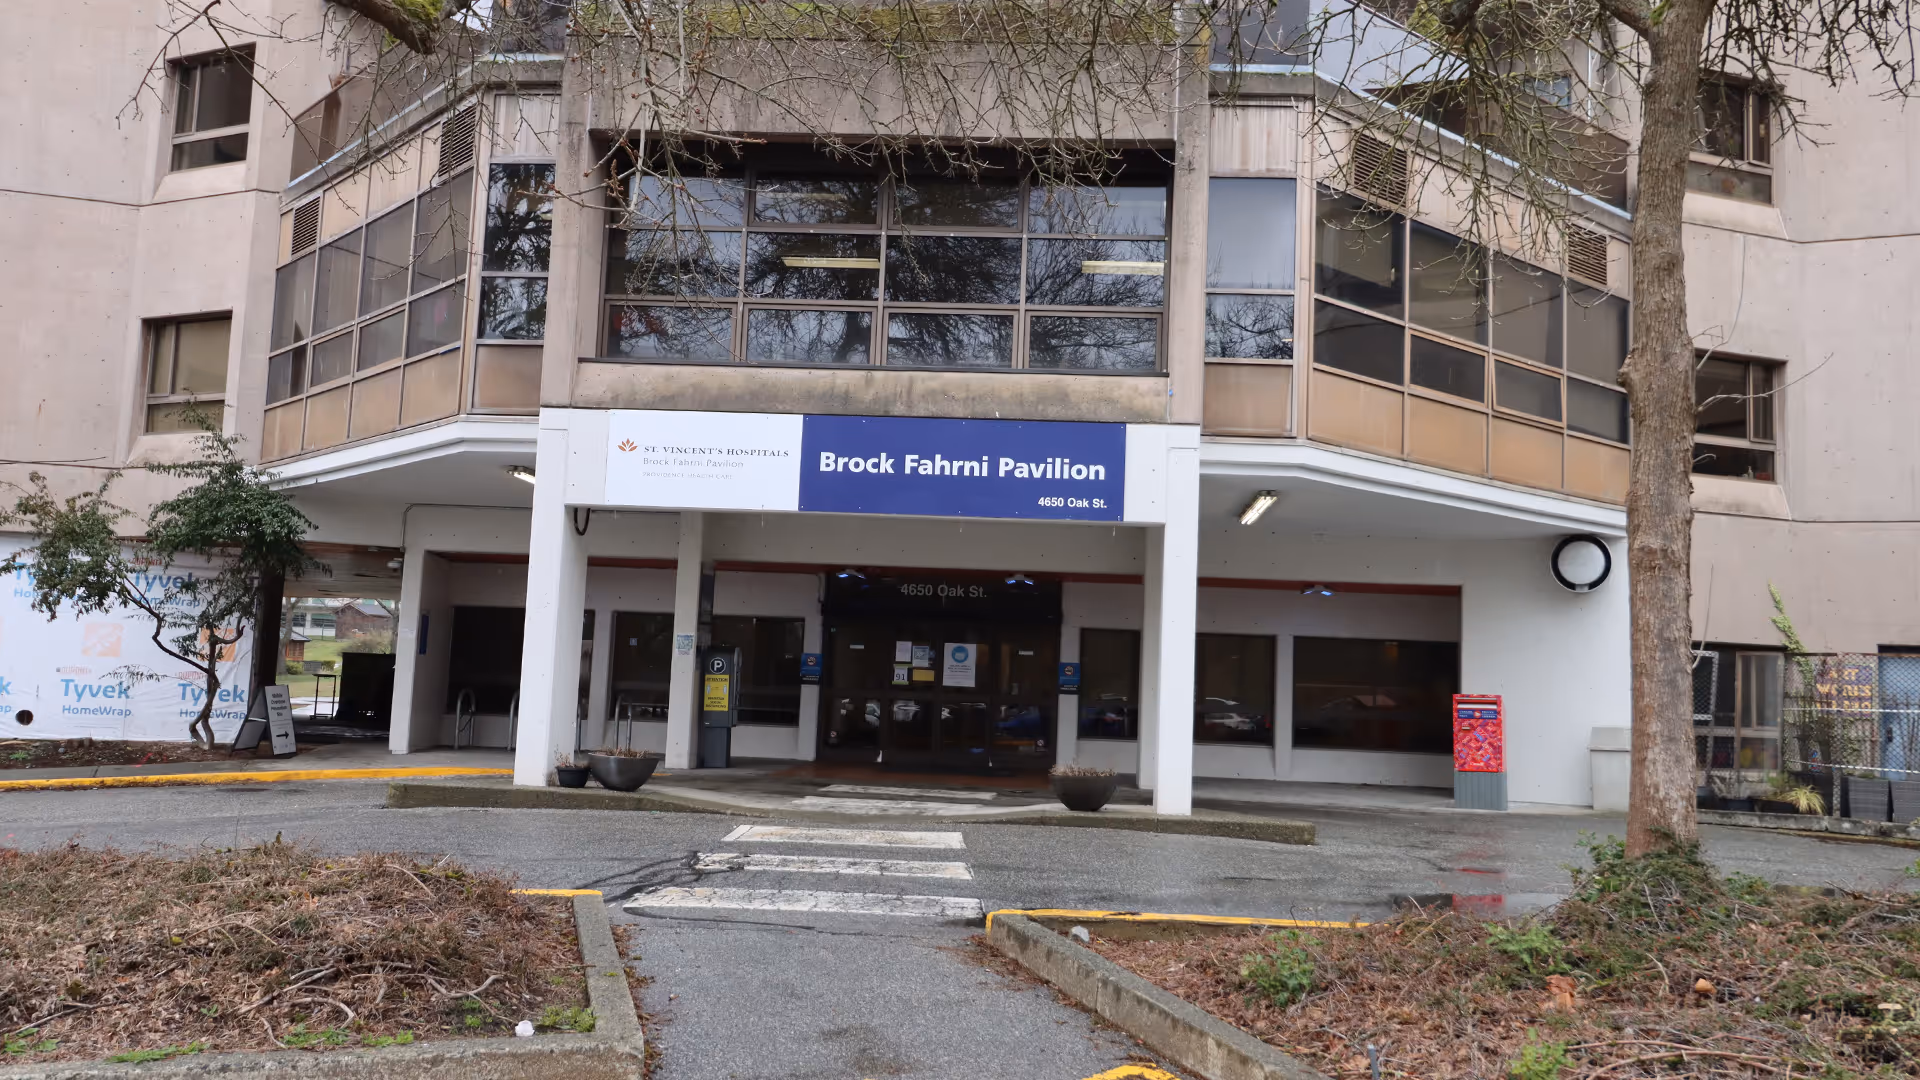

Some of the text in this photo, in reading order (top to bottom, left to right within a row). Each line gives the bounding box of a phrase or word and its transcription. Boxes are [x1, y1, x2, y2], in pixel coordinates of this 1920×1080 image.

[663, 446, 723, 455] VINCENT'S
[727, 448, 789, 457] HOSPITALS
[643, 457, 744, 468] Brock Fahrni Pavilion
[820, 452, 1106, 480] Brock Fahrni Pavilion
[1038, 497, 1107, 508] 4650 Oak St.
[900, 584, 987, 598] 4650 Oak St.
[134, 594, 200, 608] HomWrap
[895, 673, 906, 681] 91
[61, 679, 131, 702] Tyvek
[178, 683, 245, 706] Tyek
[62, 704, 132, 717] HomeWrap
[180, 708, 246, 719] HoeWrap
